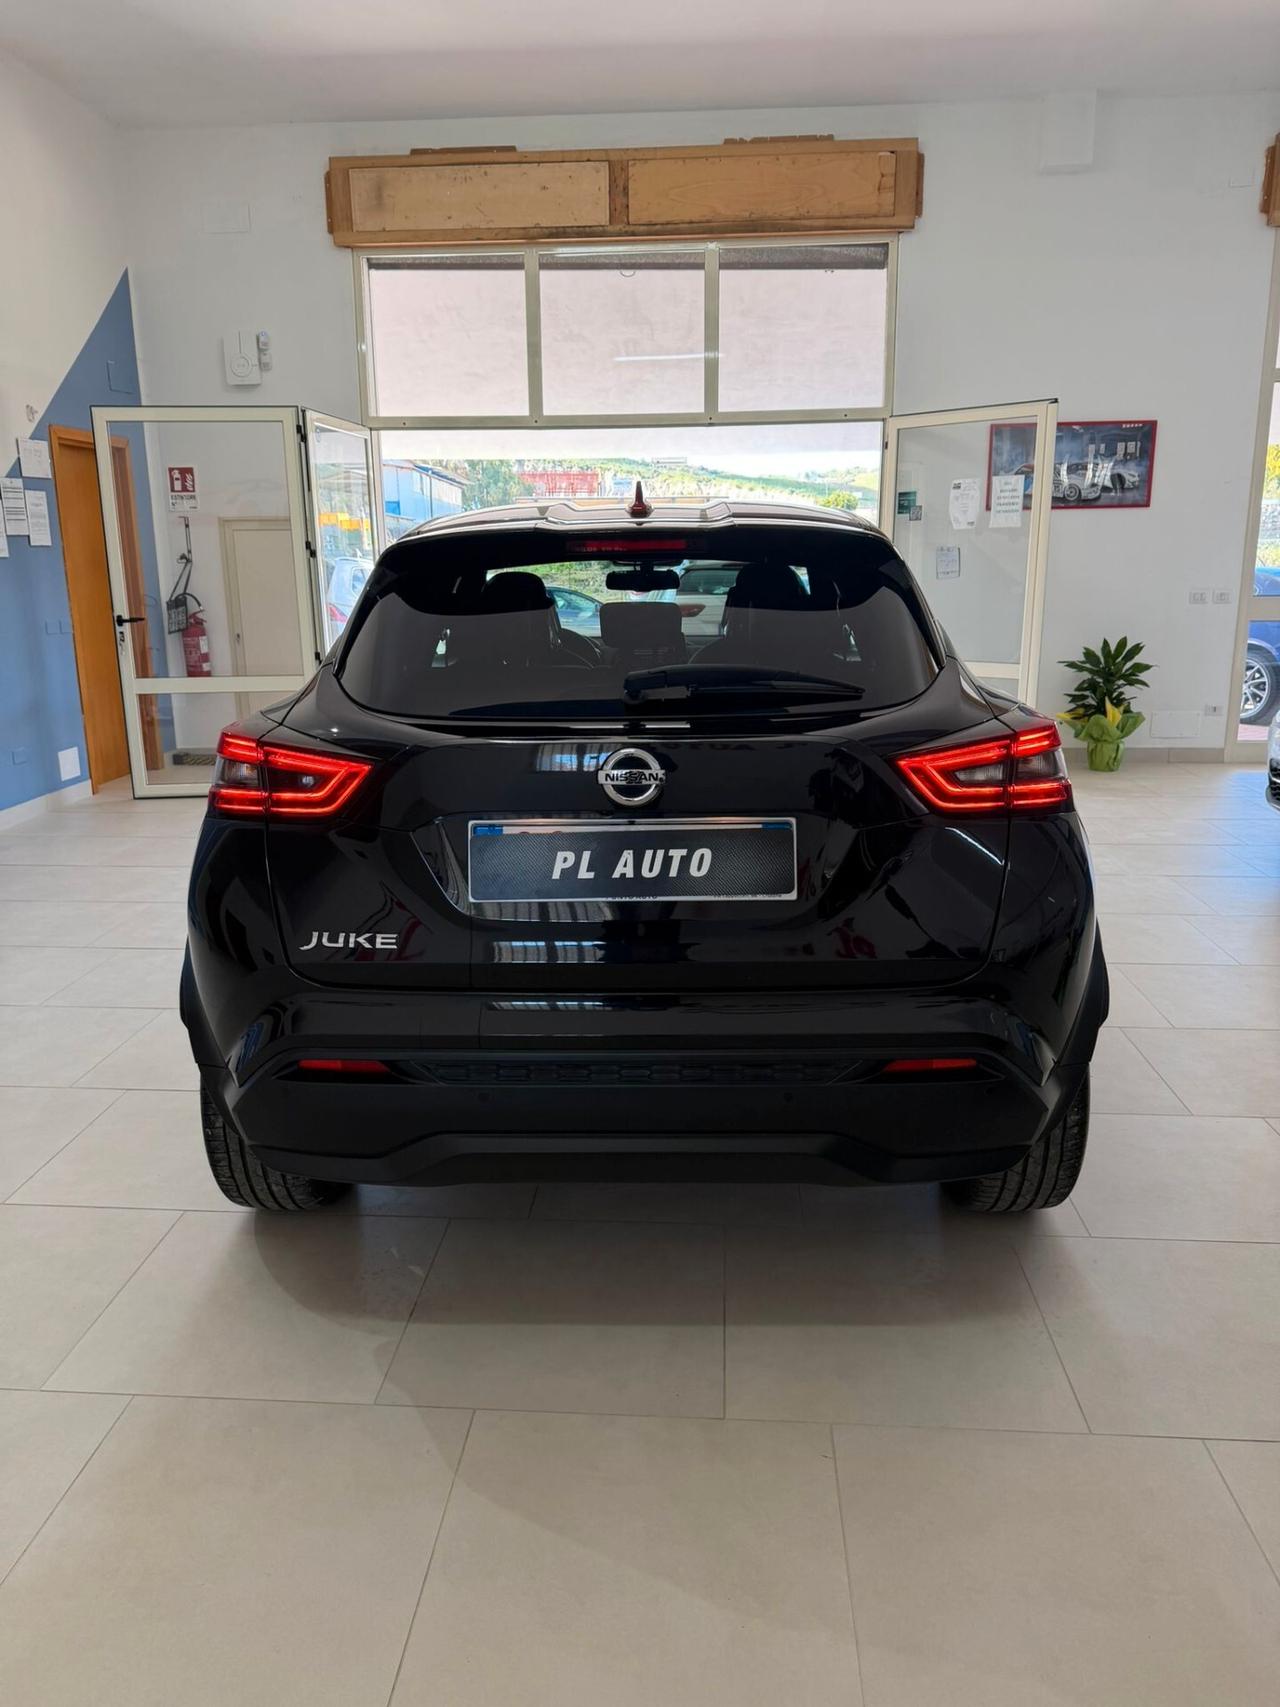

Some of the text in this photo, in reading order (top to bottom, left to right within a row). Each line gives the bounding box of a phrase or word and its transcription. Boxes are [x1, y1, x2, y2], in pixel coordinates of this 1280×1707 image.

[604, 772, 659, 783] NISSAN
[551, 847, 713, 880] PL AUTO
[298, 931, 398, 951] JUKE
